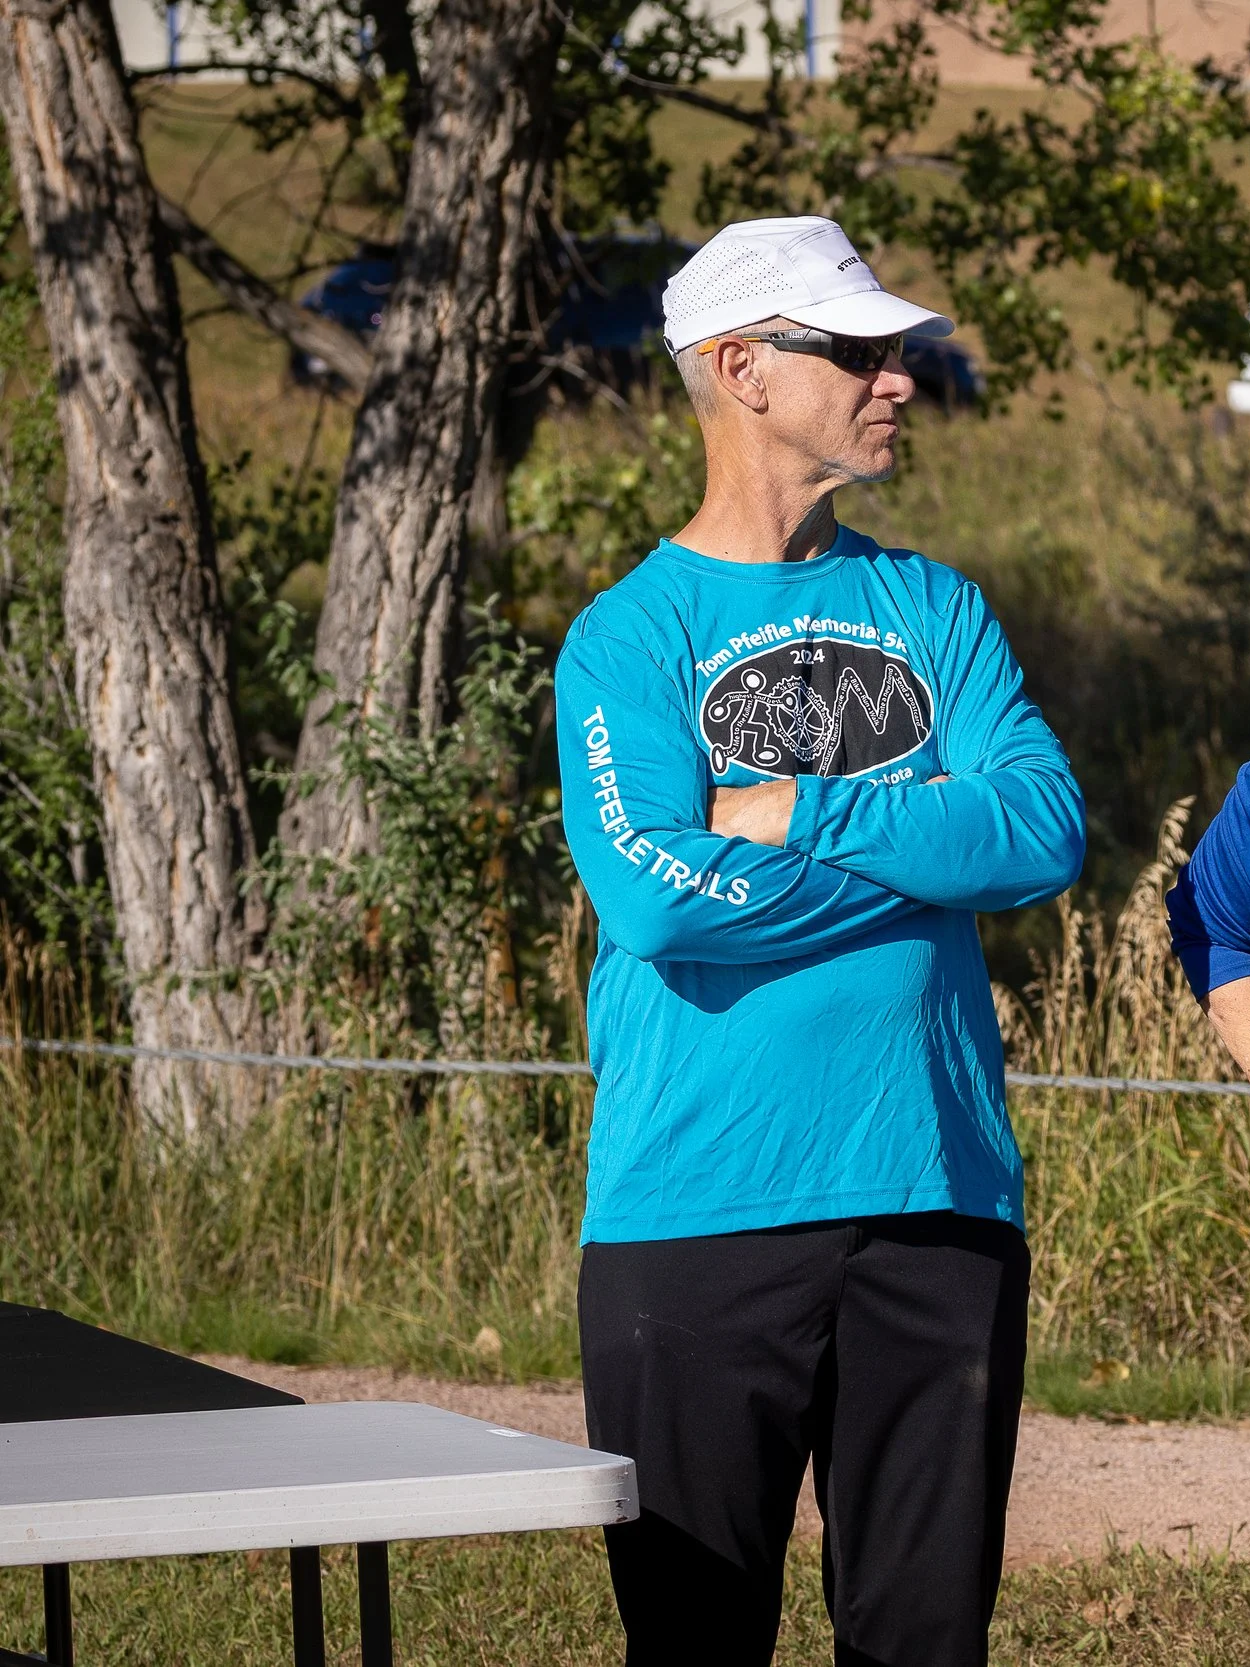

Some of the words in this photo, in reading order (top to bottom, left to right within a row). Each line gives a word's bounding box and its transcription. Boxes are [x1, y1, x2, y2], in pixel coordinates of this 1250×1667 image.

[695, 648, 733, 678] Tom
[728, 623, 793, 654] Pfeifle
[883, 632, 908, 653] 5k
[583, 705, 613, 770] TOM
[650, 847, 750, 905] TRAILS
